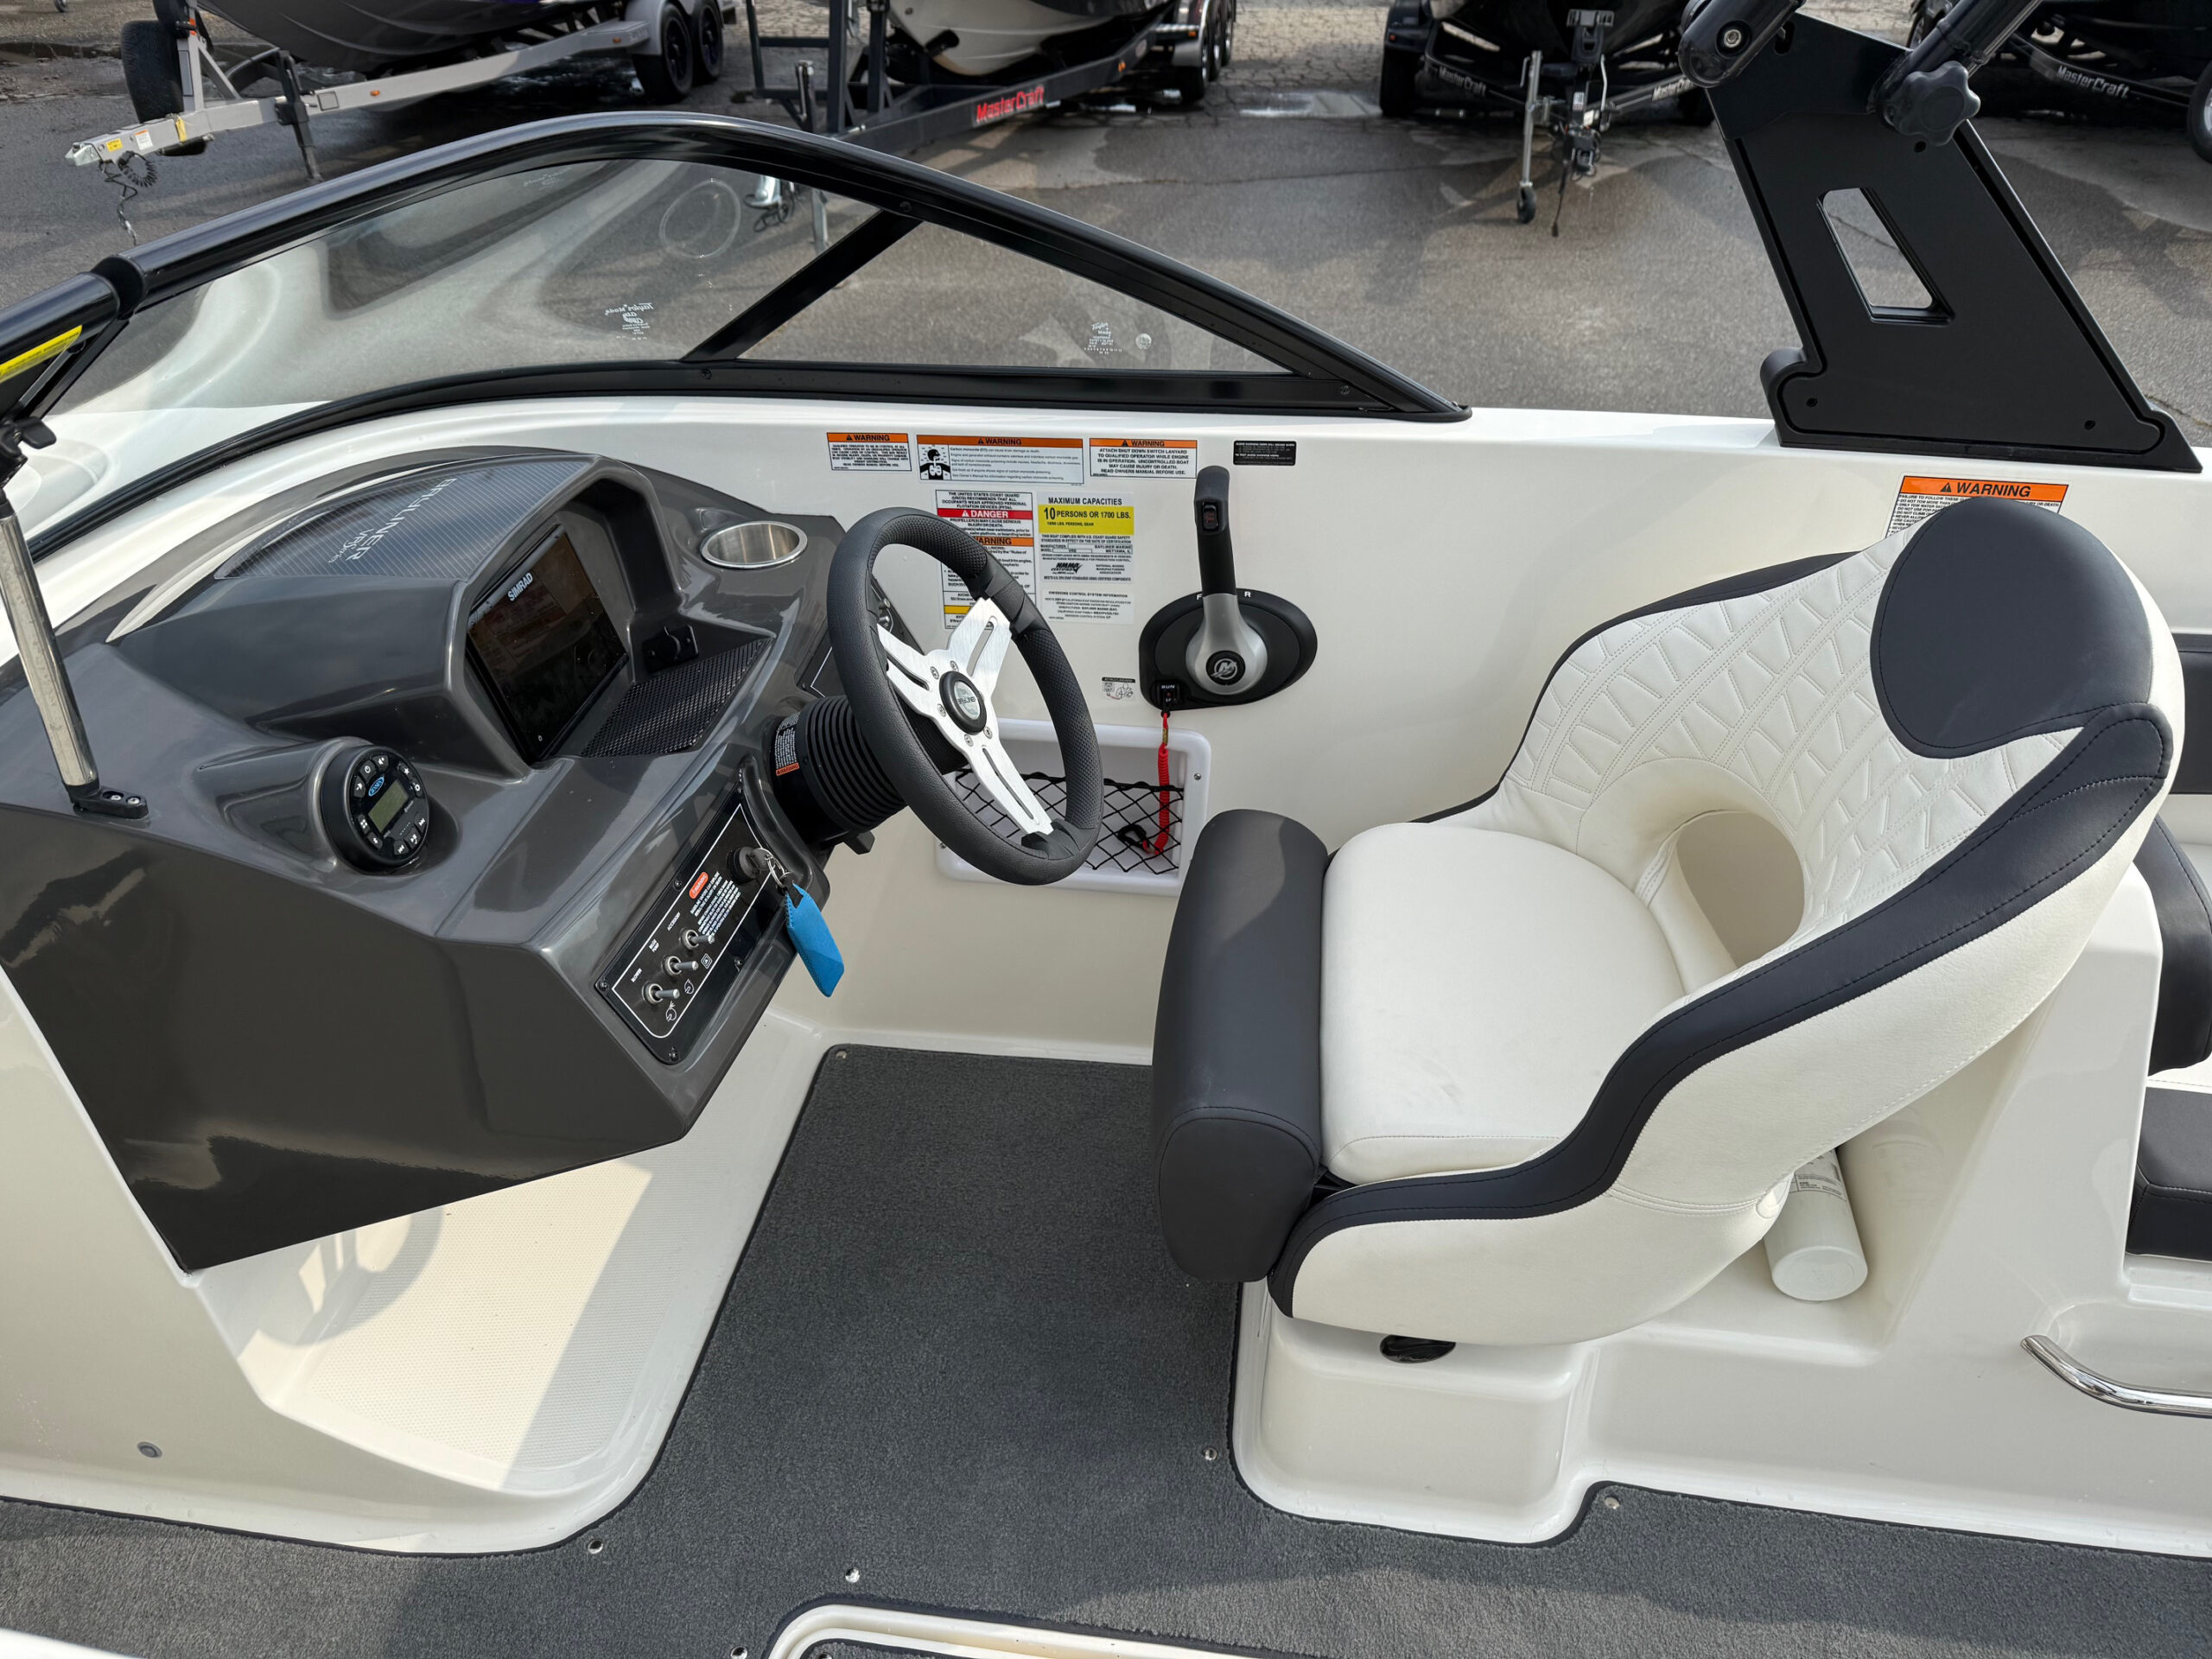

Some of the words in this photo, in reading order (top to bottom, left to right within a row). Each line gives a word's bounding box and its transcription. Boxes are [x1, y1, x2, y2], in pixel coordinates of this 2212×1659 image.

[1440, 66, 1486, 97] MasterCraft
[2056, 65, 2129, 99] MasterCraft
[976, 85, 1045, 124] MasterCraft
[1957, 482, 2031, 497] WARNING
[346, 478, 457, 561] BAYLINER
[970, 510, 1008, 518] DANGER
[1044, 507, 1056, 520] 10
[507, 572, 533, 601] SIMRAD
[667, 912, 681, 931] ACCESSORY
[630, 968, 642, 982] BLOWER
